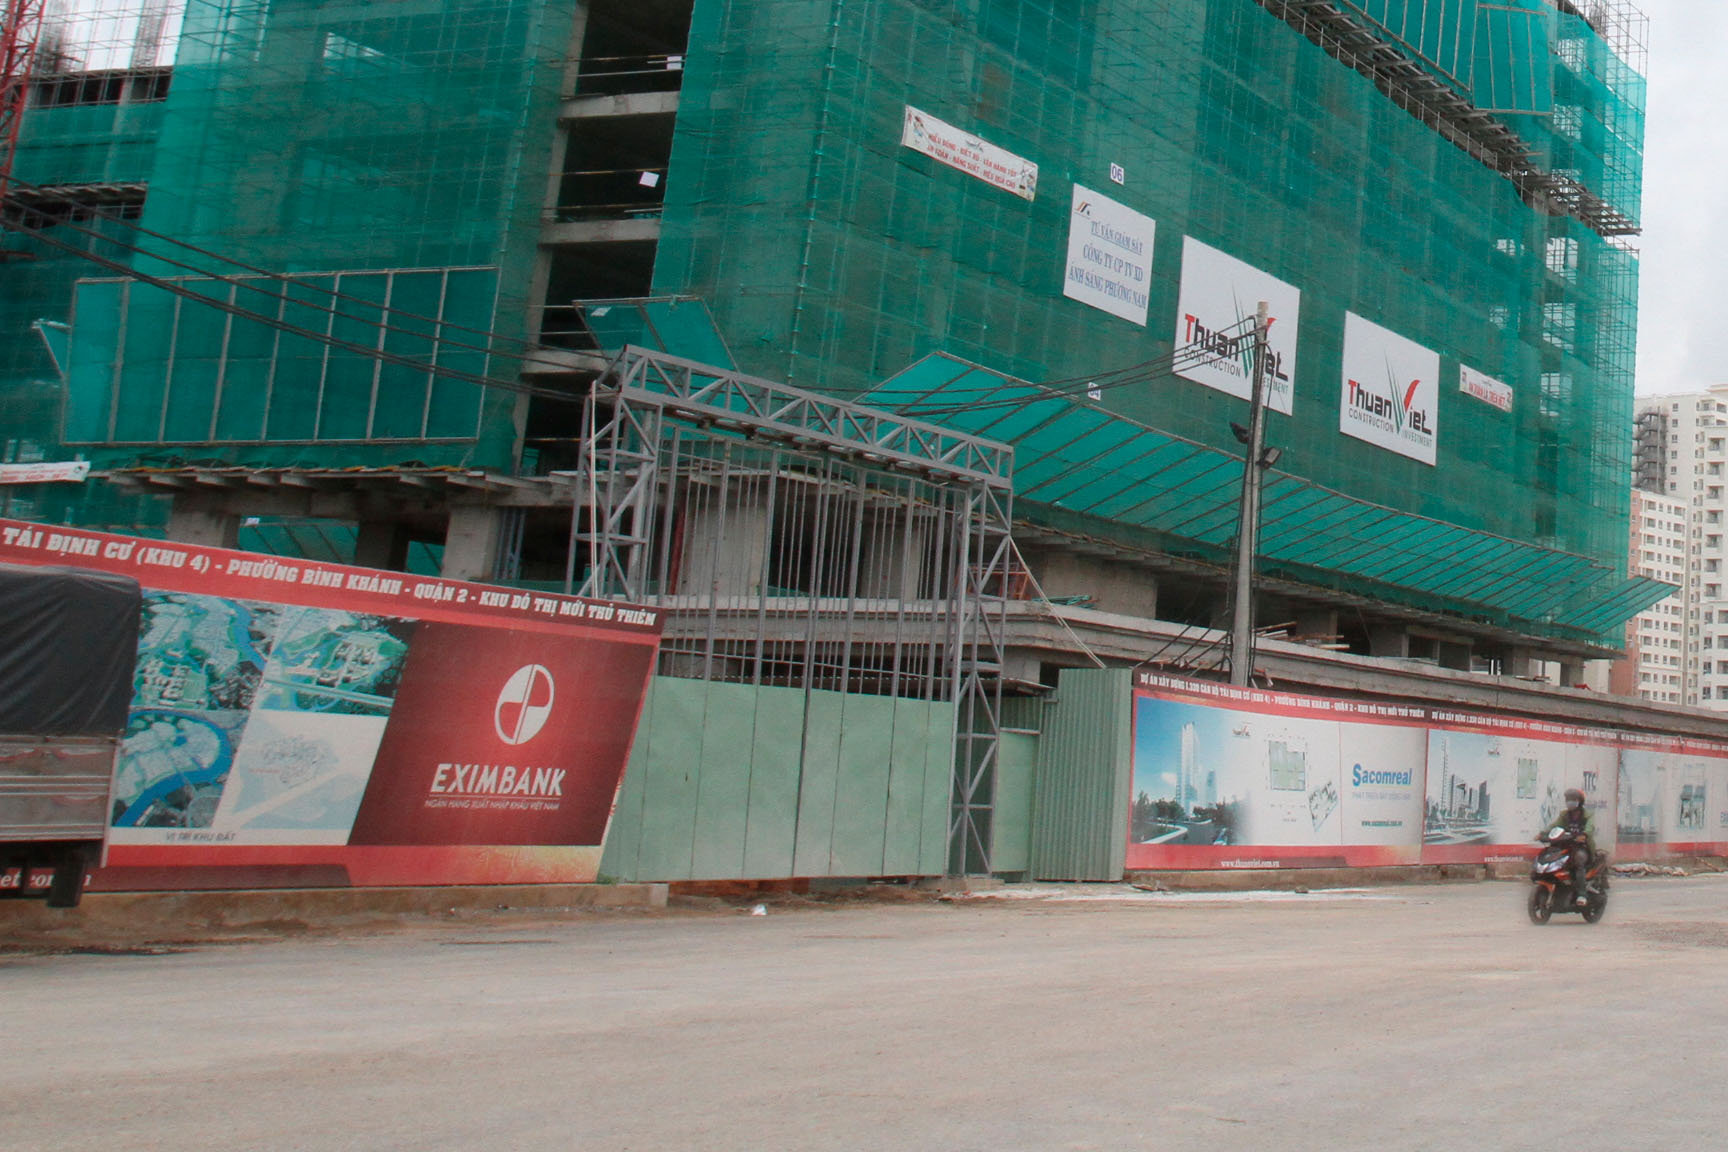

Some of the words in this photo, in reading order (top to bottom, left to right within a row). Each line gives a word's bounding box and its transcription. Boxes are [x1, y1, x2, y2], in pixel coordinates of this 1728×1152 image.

[1111, 165, 1123, 182] 06
[1348, 407, 1395, 434] CONSTRUCTION
[2, 526, 44, 549] TÁI
[46, 533, 102, 556] ĐỊNH
[104, 541, 137, 561] CƯ
[226, 559, 299, 583] PHƯỜNG
[301, 566, 345, 589] BÌNH
[346, 574, 403, 595] KHÁNH
[414, 582, 456, 603] QUẬN
[458, 588, 469, 603] 2
[479, 591, 511, 608] KHU
[534, 598, 558, 617] THỊ
[559, 599, 586, 618] MỚI
[588, 602, 615, 621] THỦ
[617, 608, 657, 627] THIÊM
[430, 763, 568, 797] EXIMBANK
[1352, 763, 1413, 787] Sacomreal
